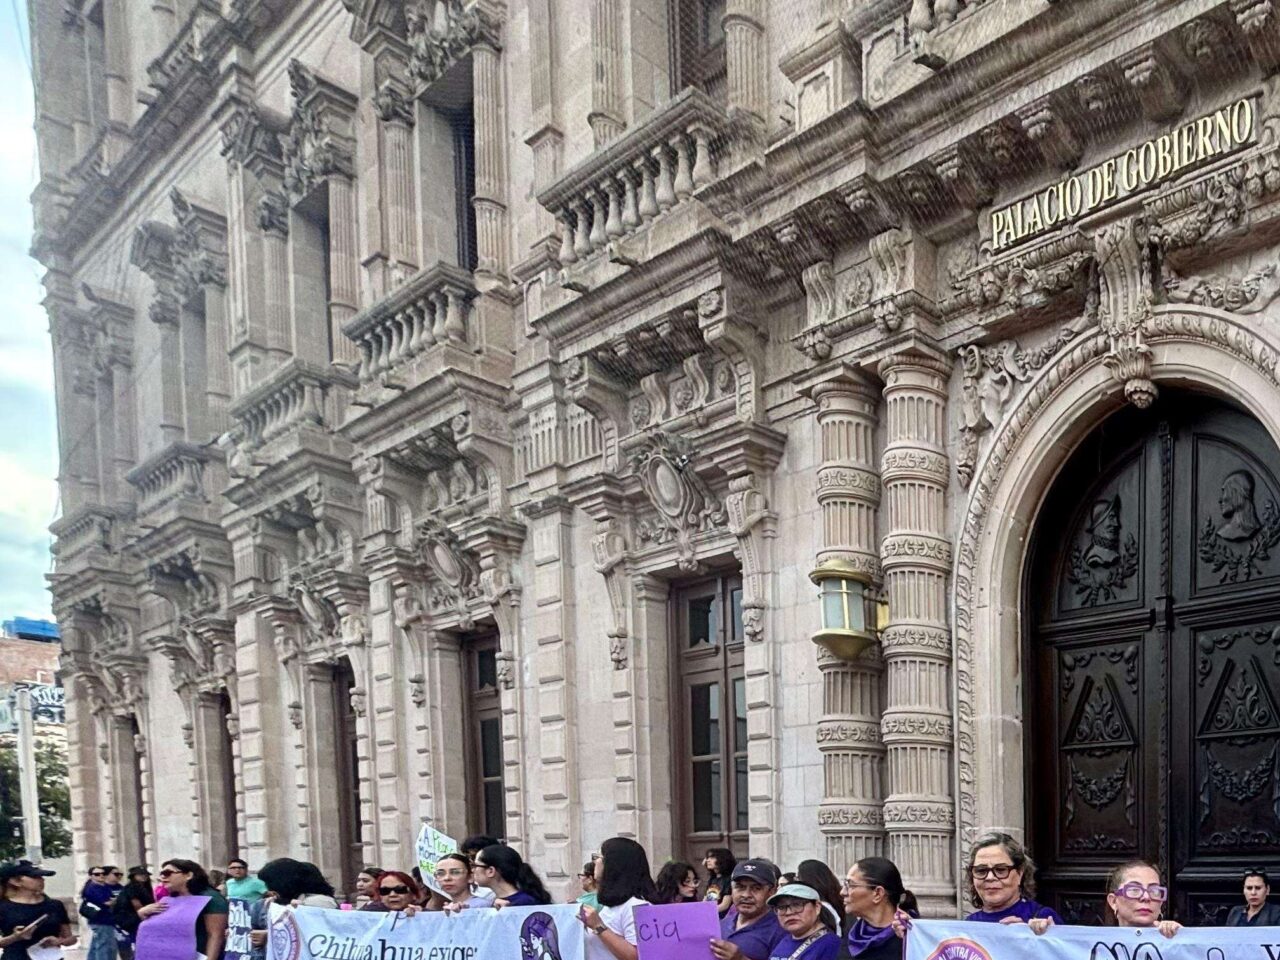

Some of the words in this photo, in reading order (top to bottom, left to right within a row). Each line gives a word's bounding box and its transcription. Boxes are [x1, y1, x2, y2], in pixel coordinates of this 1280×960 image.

[991, 175, 1083, 250] PALACIO
[1087, 157, 1119, 211] DE
[1121, 98, 1253, 192] GOBIERNO
